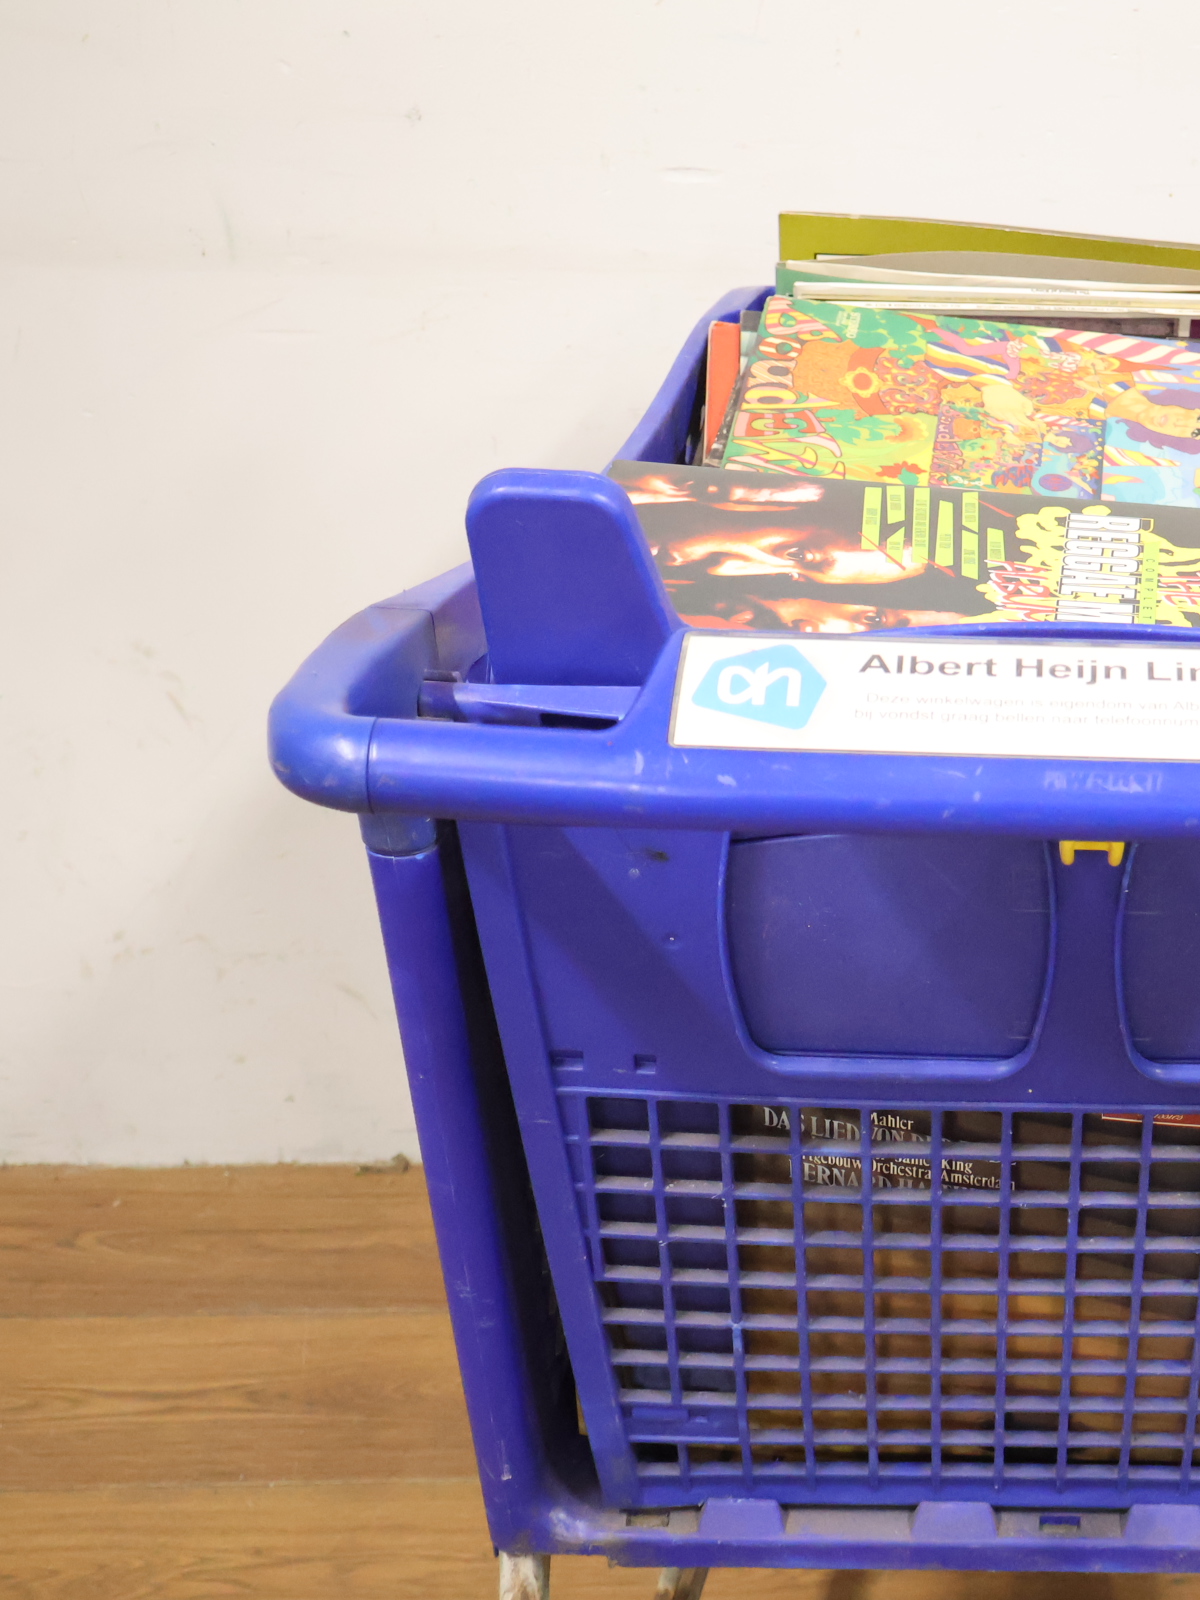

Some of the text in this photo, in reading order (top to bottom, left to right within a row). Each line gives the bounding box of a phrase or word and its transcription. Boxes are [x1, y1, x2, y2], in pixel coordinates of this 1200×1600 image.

[1058, 512, 1142, 599] REGGAE
[858, 653, 997, 677] Albert
[1014, 657, 1128, 685] Heijn
[866, 692, 910, 704] Deze
[916, 695, 1024, 708] winkelwagen
[1031, 698, 1043, 707] is
[1049, 699, 1132, 710] eigendom
[1139, 701, 1168, 711] van
[854, 708, 872, 720] bij
[879, 709, 935, 720] vondst
[940, 712, 989, 723] graag
[995, 712, 1045, 723] bellen
[1052, 715, 1088, 724] naar
